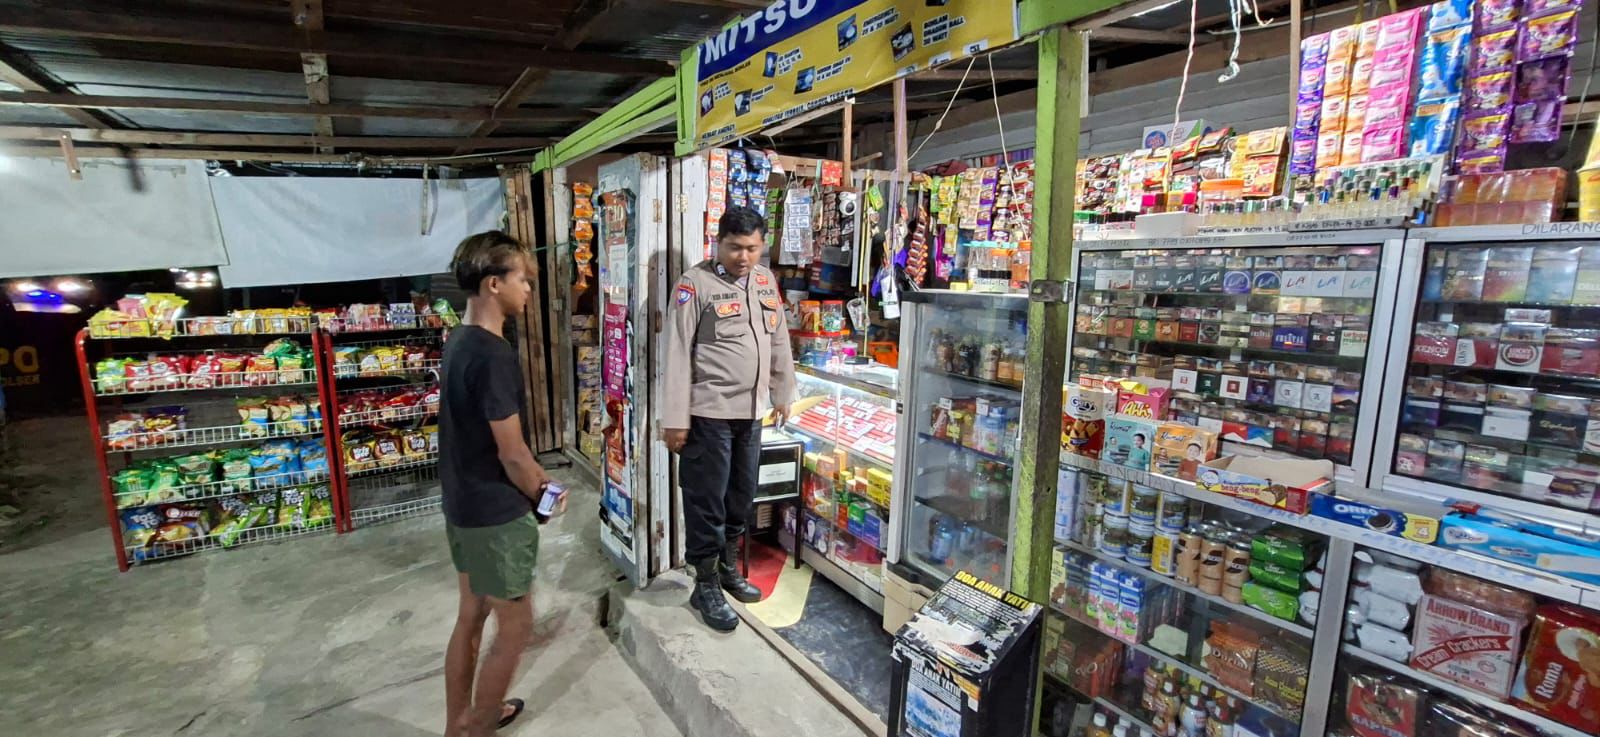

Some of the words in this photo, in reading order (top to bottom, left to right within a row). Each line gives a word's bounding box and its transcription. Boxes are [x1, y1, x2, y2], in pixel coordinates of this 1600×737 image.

[884, 14, 900, 27] WATT
[922, 23, 948, 38] DRAGON
[949, 16, 965, 28] BALL
[923, 14, 949, 29] BOHLAM
[931, 32, 948, 43] WATT
[1286, 276, 1306, 287] LA
[1317, 277, 1338, 288] LA
[1220, 484, 1262, 496] beng-beng
[1333, 503, 1379, 516] OREO
[1417, 526, 1428, 537] 4
[954, 569, 976, 586] DOA
[975, 580, 1006, 599] ANAK
[1426, 598, 1469, 623] ARROW
[1470, 609, 1511, 635] BRAND
[1416, 647, 1451, 668] Cream
[1446, 637, 1502, 655] Crackers
[1535, 662, 1563, 699] Roma
